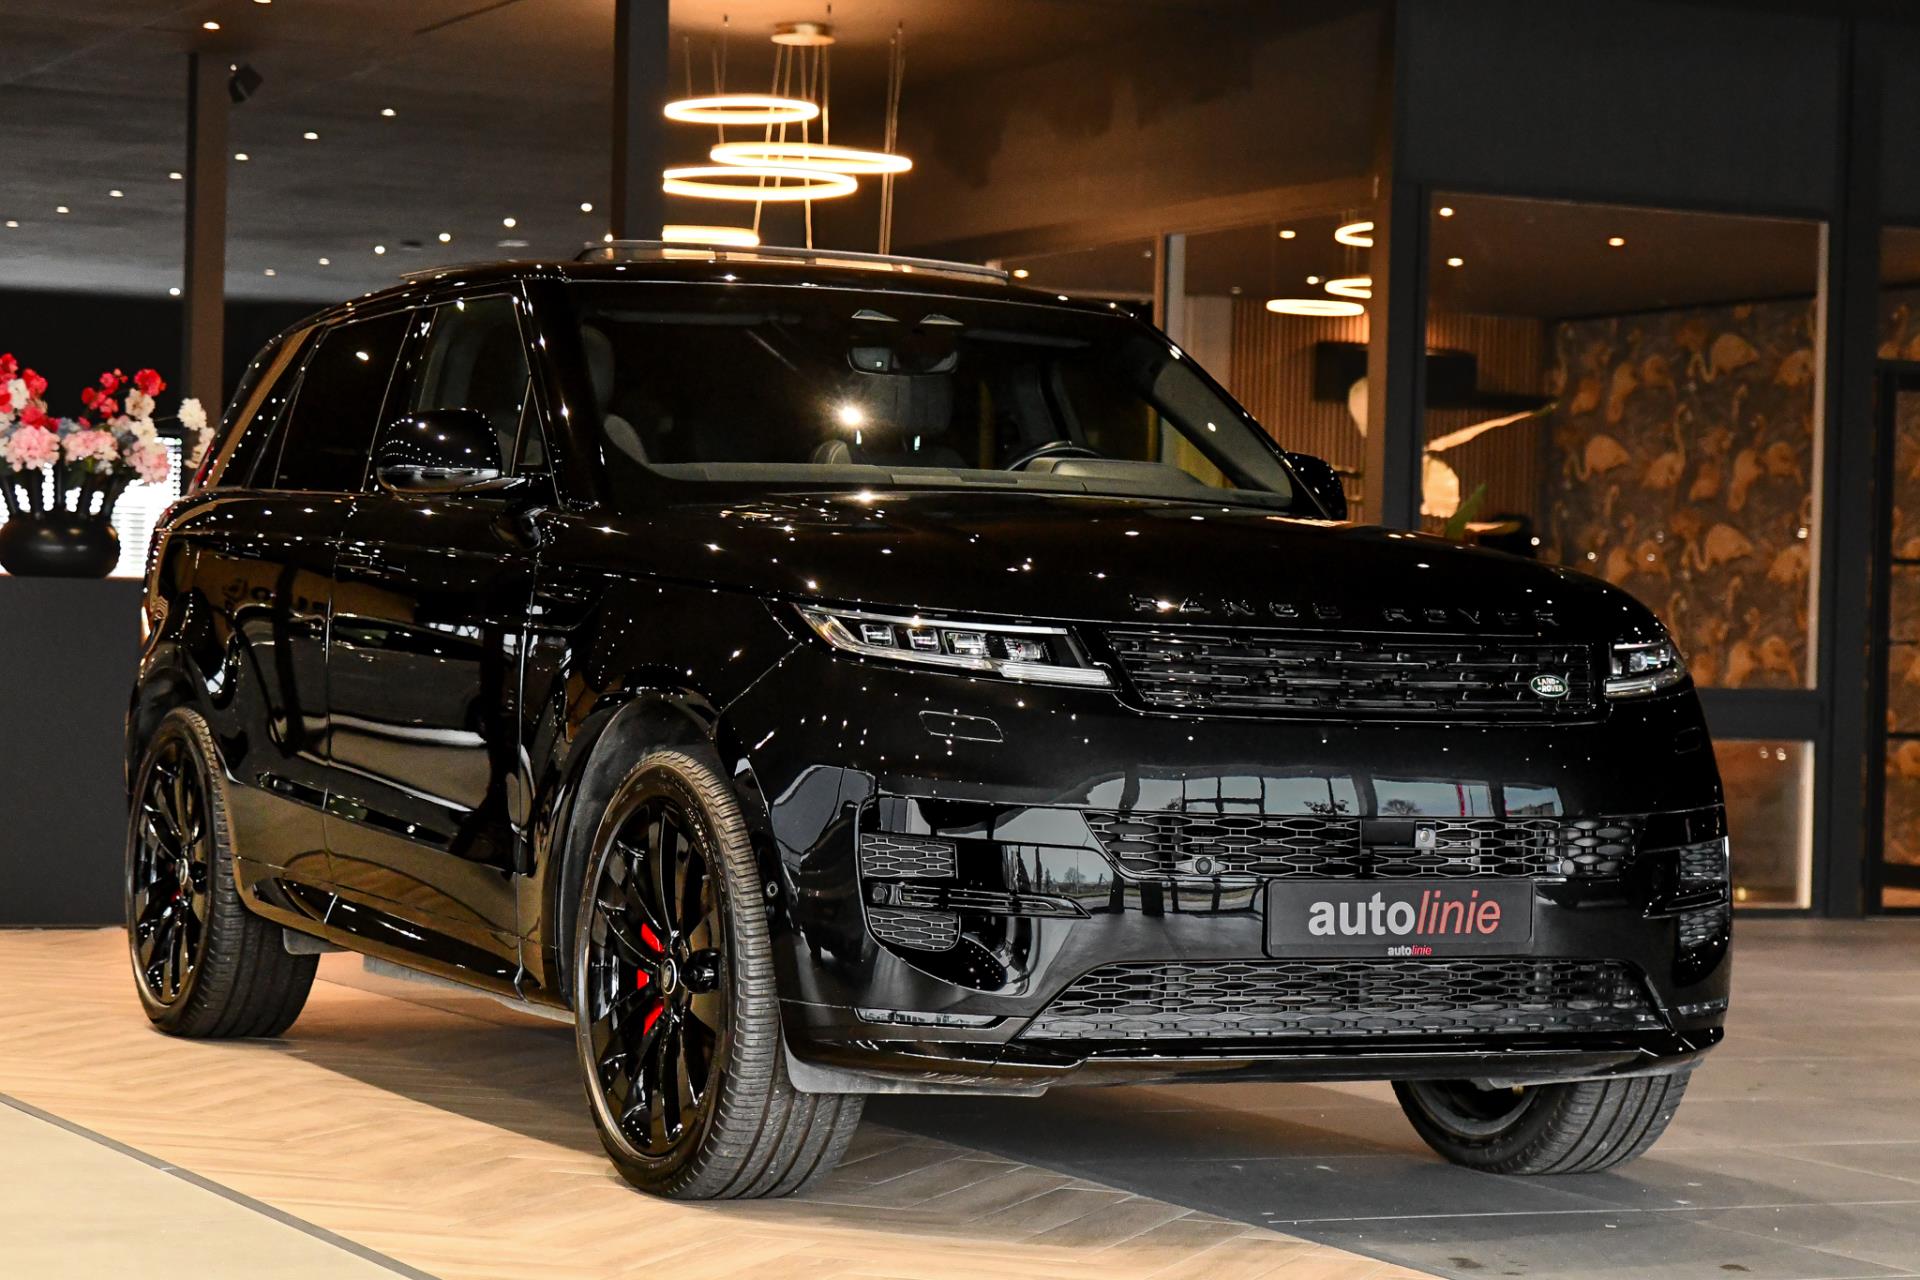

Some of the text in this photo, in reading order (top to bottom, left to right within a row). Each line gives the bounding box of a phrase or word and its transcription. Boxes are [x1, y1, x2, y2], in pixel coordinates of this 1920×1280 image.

[1128, 593, 1561, 626] RANGE ROVER
[1536, 677, 1556, 686] LAND
[1541, 684, 1564, 693] ROVER
[1308, 889, 1501, 936] autolinie
[1387, 945, 1432, 956] autolinie
